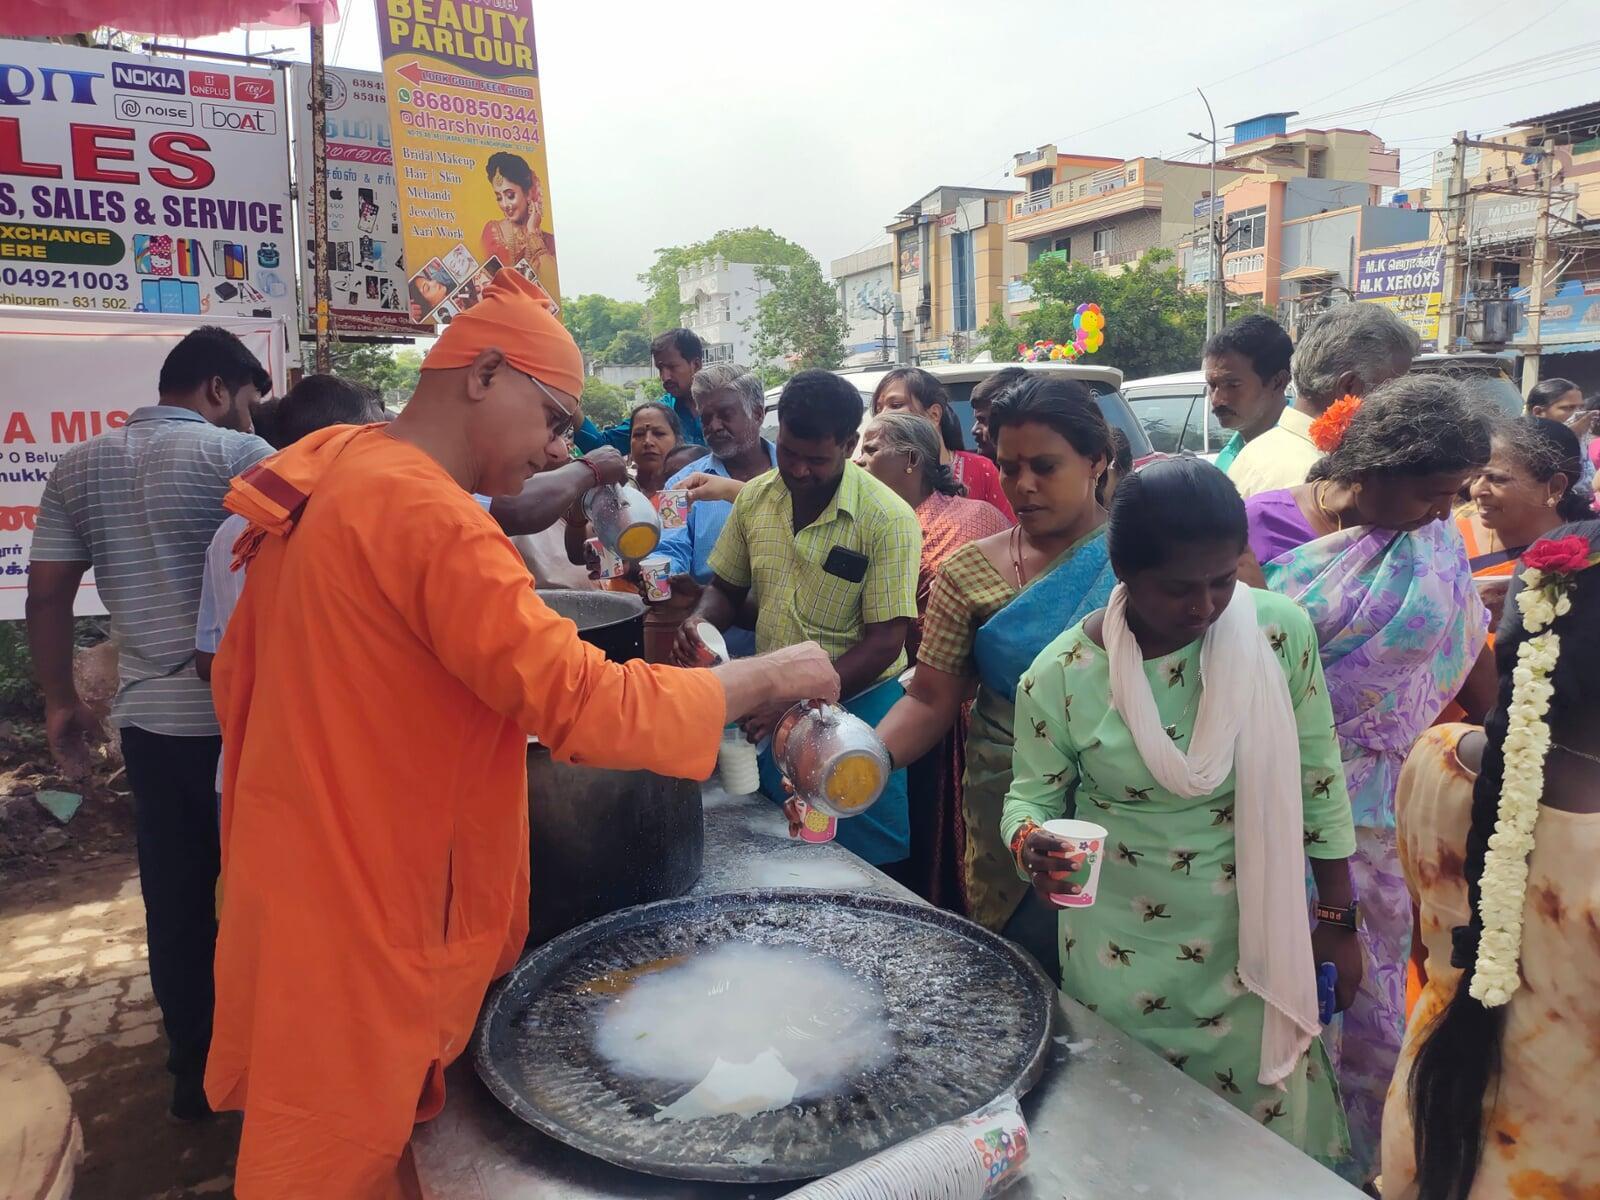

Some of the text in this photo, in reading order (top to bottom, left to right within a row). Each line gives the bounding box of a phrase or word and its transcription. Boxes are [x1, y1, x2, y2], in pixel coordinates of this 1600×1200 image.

[386, 0, 528, 43] BEAUTY
[389, 18, 534, 70] PARLOUR
[115, 67, 181, 89] NOKIA
[422, 71, 449, 83] LOOK
[192, 85, 230, 97] ONEPLUS
[412, 89, 539, 126] 8680850344
[415, 111, 540, 144] dharshvino344
[402, 147, 476, 170] Bridal Makeup
[405, 166, 462, 184] Hair Skin
[407, 186, 451, 201] Mehandi
[32, 185, 126, 224] SALES
[134, 198, 156, 225] &
[163, 195, 284, 234] SERVICE
[409, 205, 456, 223] Jewellery
[413, 225, 464, 239] Aari Work
[0, 268, 129, 291] 04921003
[1360, 271, 1440, 293] M.K XEROXS
[72, 296, 97, 308] 631
